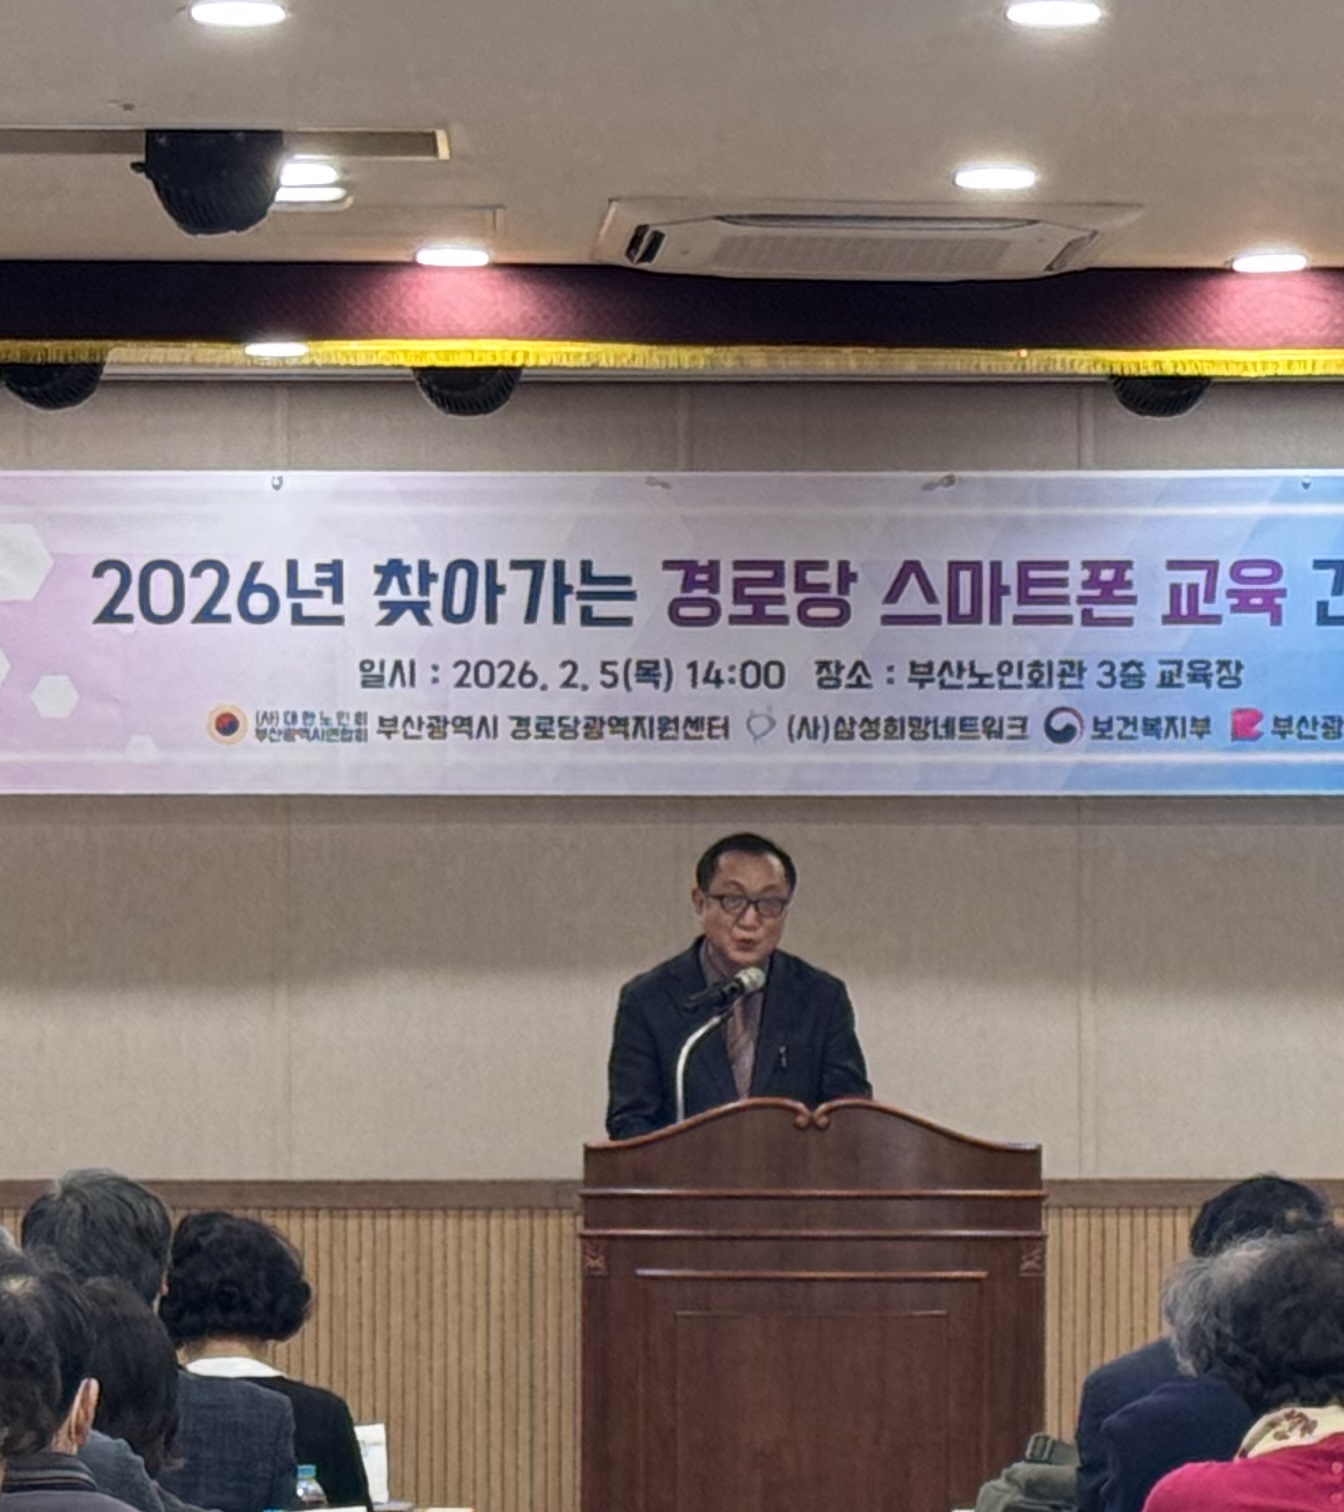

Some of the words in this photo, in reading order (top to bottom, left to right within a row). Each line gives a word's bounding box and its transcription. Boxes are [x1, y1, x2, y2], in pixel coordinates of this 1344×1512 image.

[92, 559, 345, 627] 2026년
[373, 558, 637, 627] 찾아가는
[662, 560, 858, 628] 경로당
[881, 560, 1137, 627] 스마트폰
[1162, 559, 1287, 627] 교육
[359, 659, 416, 689] 일시
[453, 659, 548, 691] 2026.
[559, 659, 589, 691] 2.
[600, 658, 673, 693] 5(목)
[687, 659, 785, 689] 14:00
[815, 660, 873, 690] 장소
[908, 660, 1087, 690] 부산노인회관
[1096, 660, 1146, 690] 3층
[1156, 660, 1244, 690] 교육장
[376, 715, 499, 741] 부산광역시
[508, 715, 730, 741] 경로당광역지원센터
[1091, 715, 1212, 741] 보건복지부
